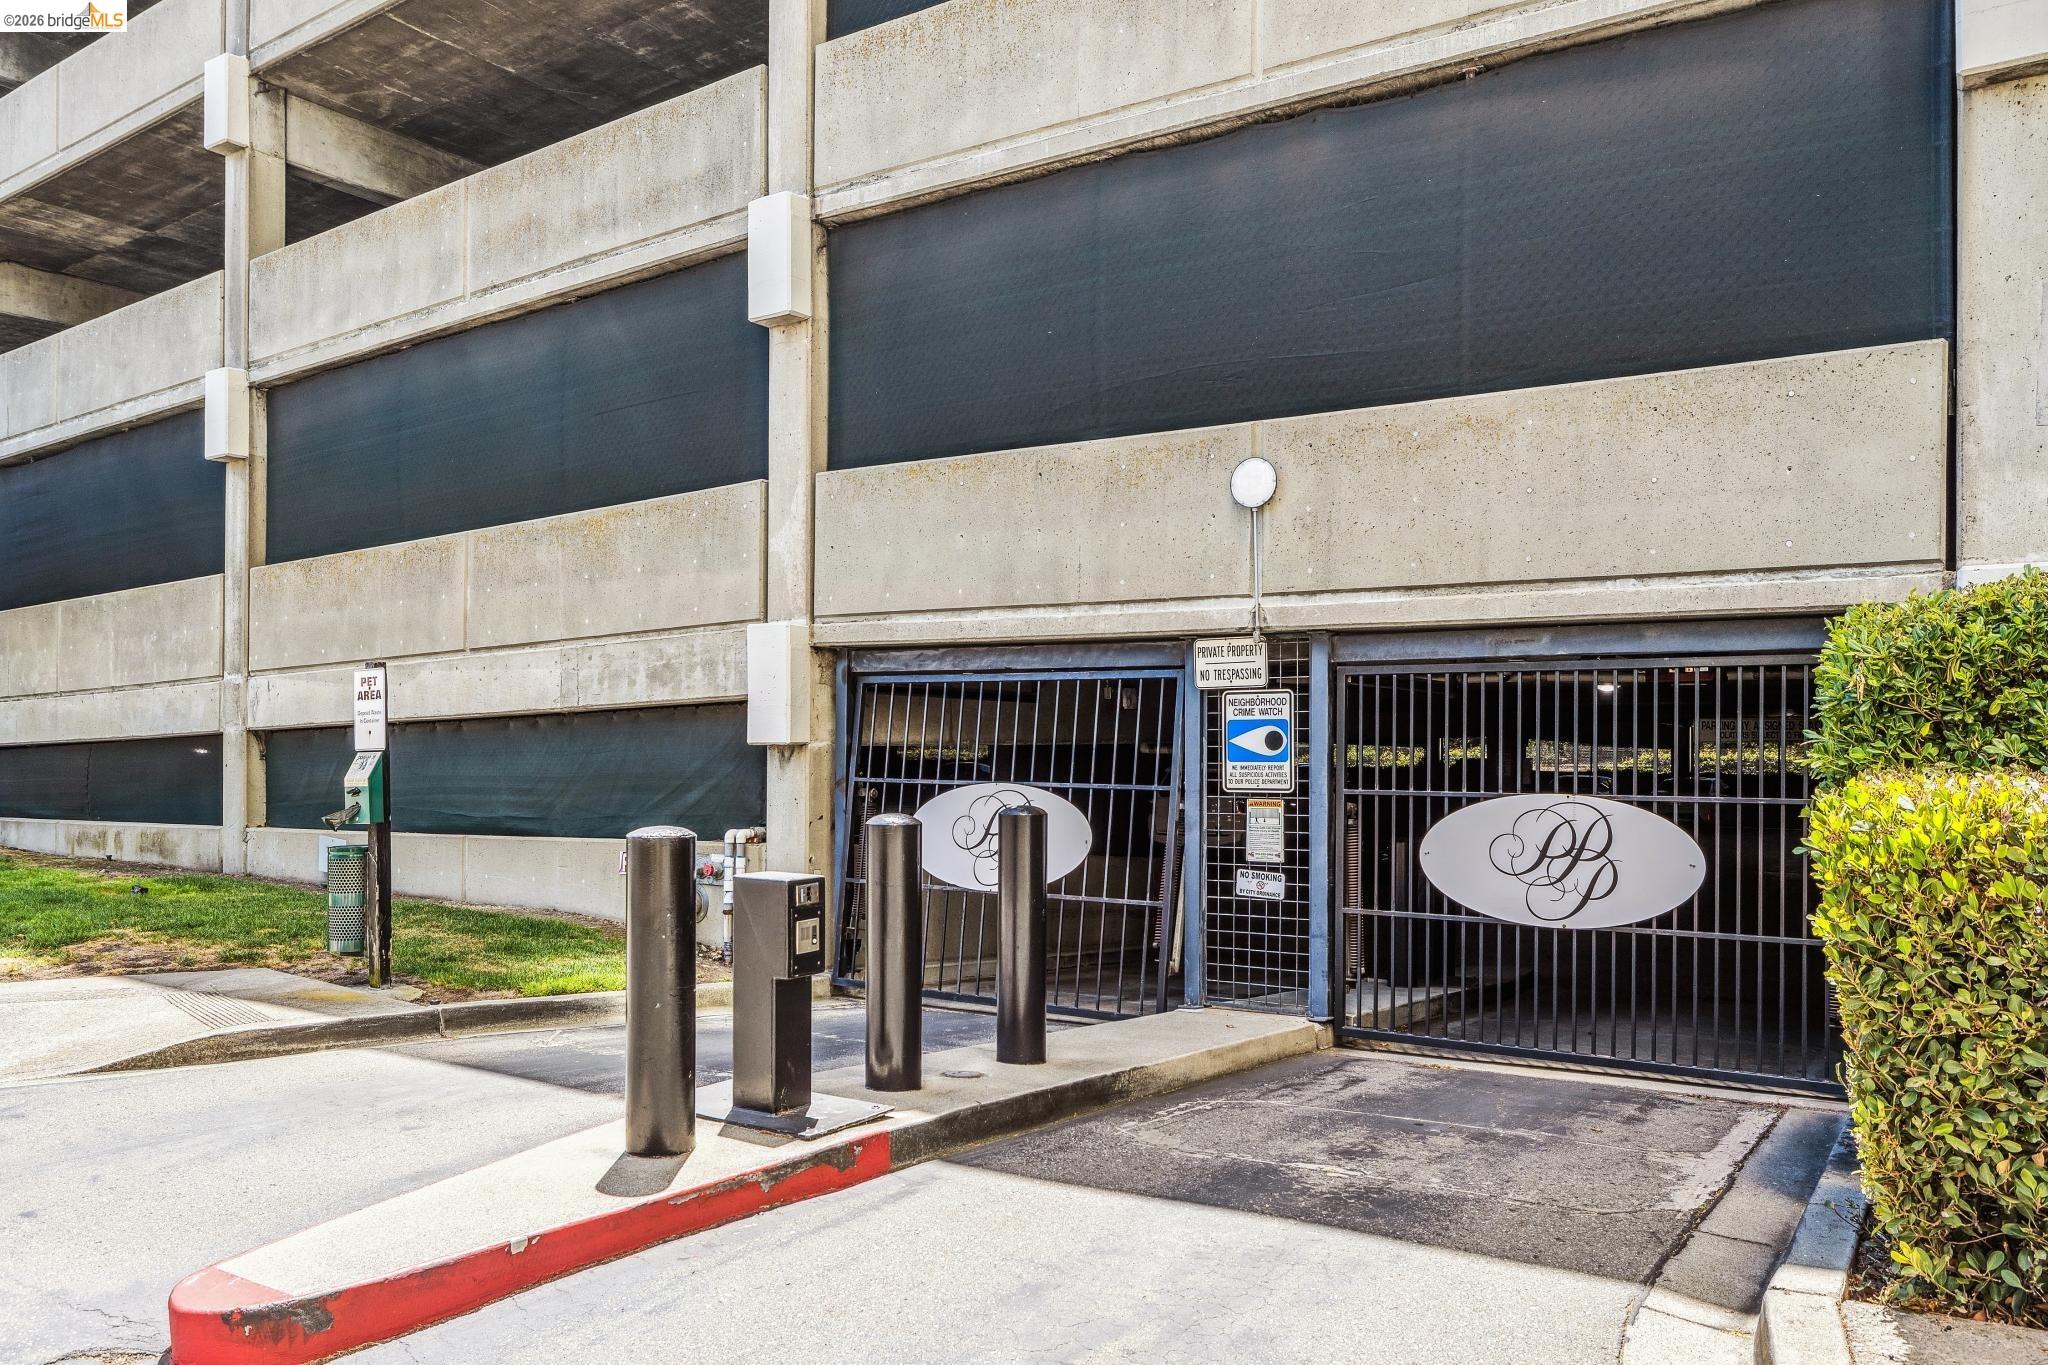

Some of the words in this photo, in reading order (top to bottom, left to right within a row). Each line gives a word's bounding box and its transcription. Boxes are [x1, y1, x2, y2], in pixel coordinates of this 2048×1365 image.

[1197, 645, 1225, 659] PRIVATE
[1227, 643, 1263, 657] PROPERTY
[1200, 669, 1210, 681] NO
[1213, 667, 1262, 681] TRESPASSING
[360, 676, 378, 687] PET
[357, 689, 382, 701] AREA
[1228, 697, 1287, 707] NEIGHBORHOOD
[1233, 708, 1255, 717] CRIME
[1258, 707, 1283, 716] WATCH
[1701, 720, 1736, 730] PARING
[1240, 870, 1250, 879] NO
[1251, 871, 1283, 883] SMOKING
[1256, 890, 1281, 898] ORDINANCE
